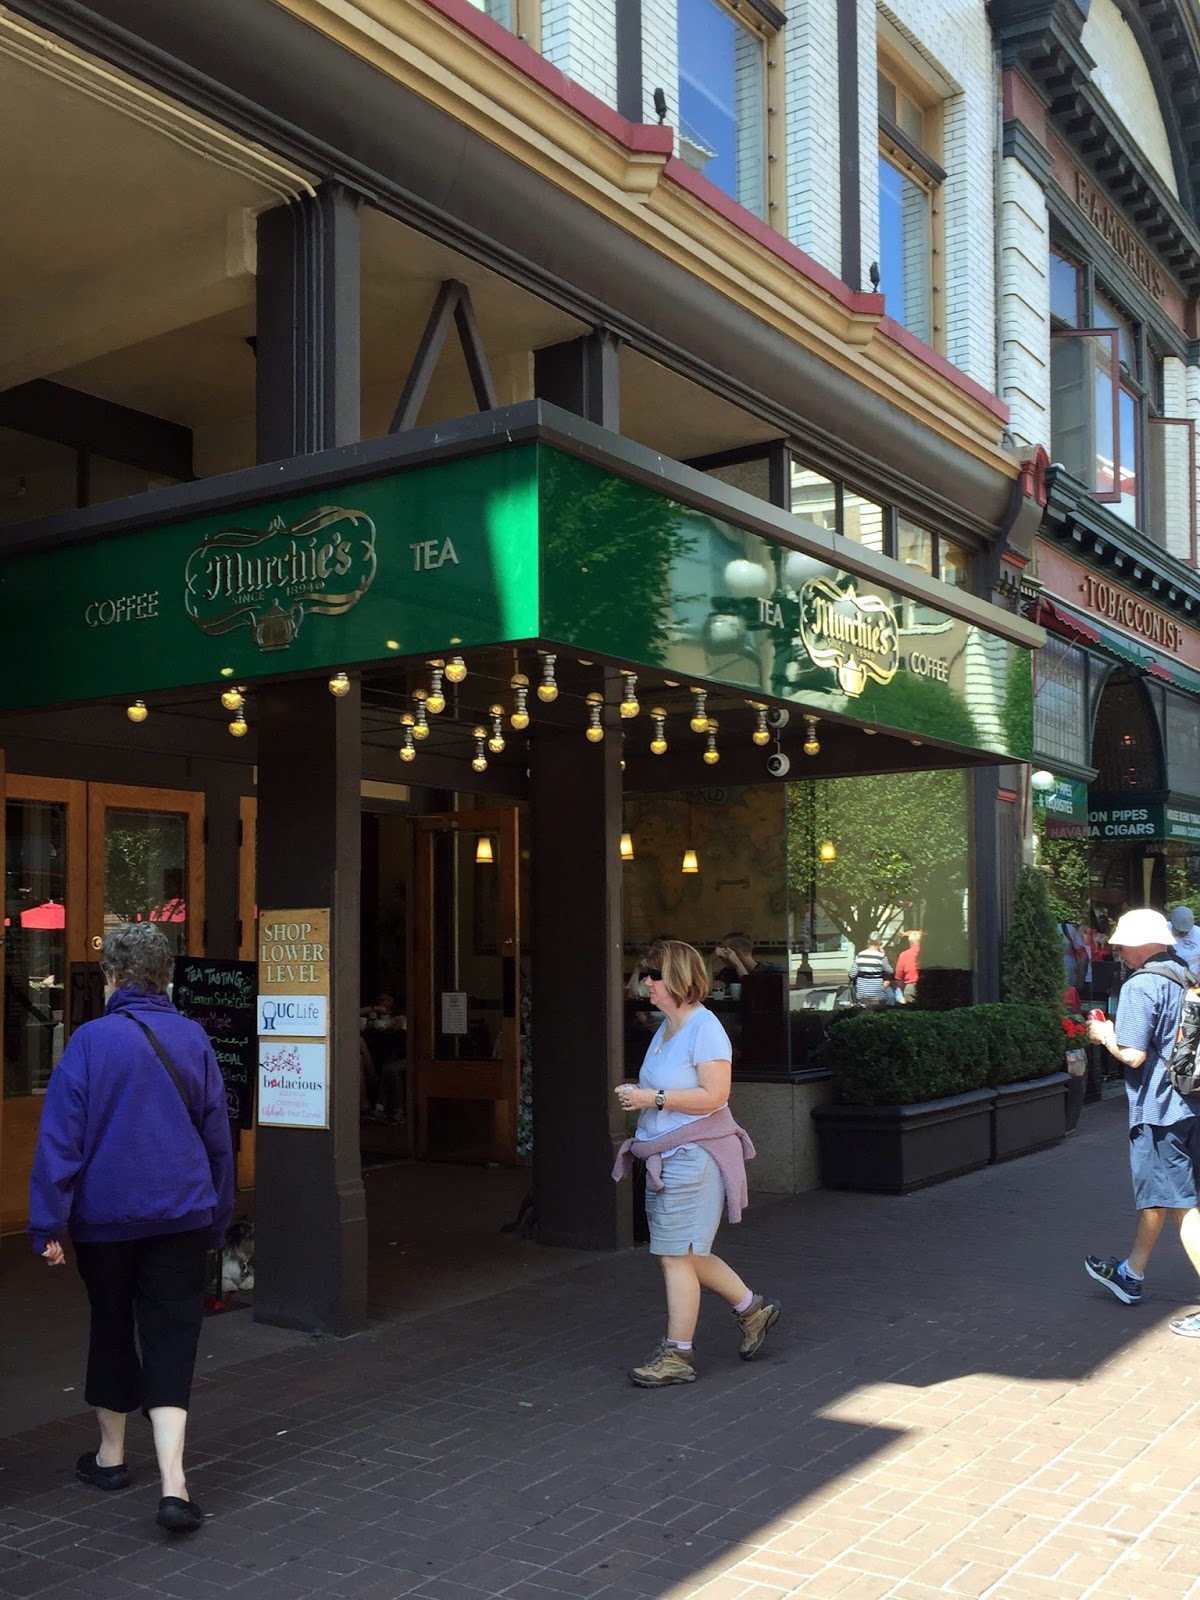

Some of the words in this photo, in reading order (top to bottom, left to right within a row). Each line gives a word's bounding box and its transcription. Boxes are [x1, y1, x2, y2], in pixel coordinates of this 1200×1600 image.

[409, 537, 459, 572] TEA
[202, 532, 352, 600] Murchie's
[231, 591, 265, 604] SINCE
[84, 591, 159, 628] COFFEE
[757, 597, 785, 628] TEA
[1086, 576, 1182, 652] TOBACCONIST
[811, 596, 888, 655] Murchie's
[911, 651, 949, 683] COFFEE
[1112, 809, 1149, 821] PIPES
[1104, 823, 1155, 836] CIGARS
[264, 923, 311, 942] SHOP
[261, 944, 325, 962] LOWER
[185, 965, 203, 982] TEA
[204, 968, 244, 989] TASTING
[266, 965, 320, 983] LEVEL
[214, 1050, 243, 1066] PECIAL
[263, 1074, 323, 1090] bodacious
